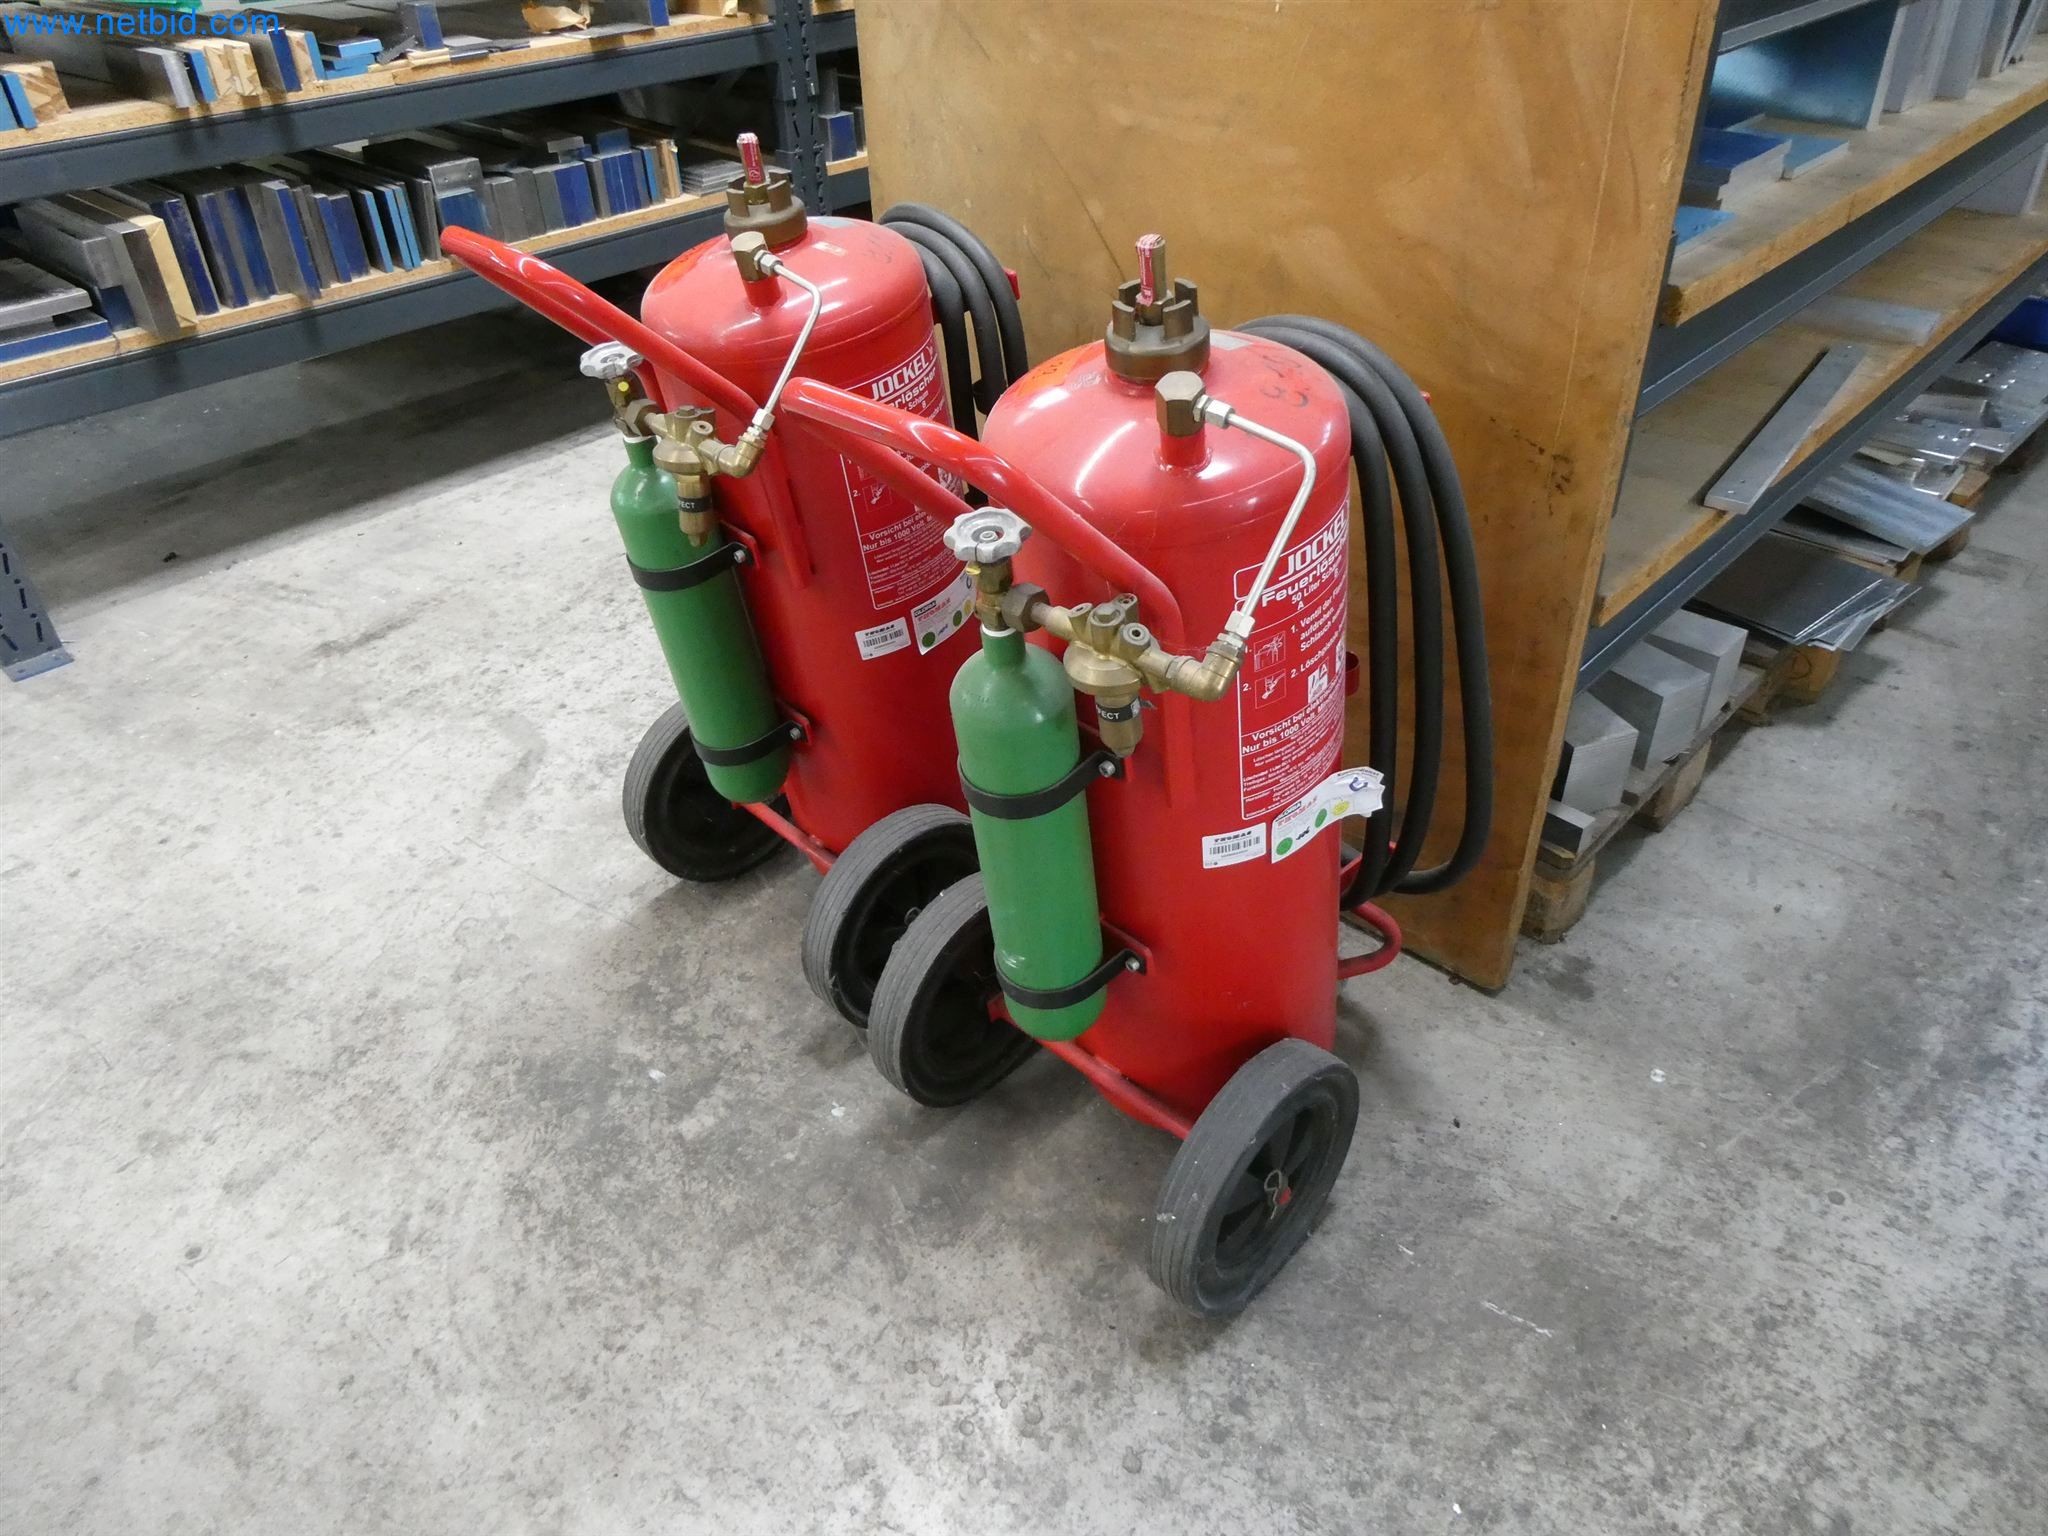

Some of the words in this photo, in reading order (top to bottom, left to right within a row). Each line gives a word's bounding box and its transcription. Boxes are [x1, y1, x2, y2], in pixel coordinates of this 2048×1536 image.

[871, 352, 929, 400] JOCKEL
[869, 524, 902, 540] Vorsicht
[863, 541, 877, 552] Nur
[1279, 509, 1345, 581] JOCKEL
[1292, 592, 1303, 604] 50
[1303, 579, 1321, 597] Liter
[1297, 601, 1304, 611] A
[1243, 683, 1251, 692] 2.
[1252, 719, 1291, 741] Vorsicht
[1293, 710, 1305, 723] bei
[1242, 742, 1260, 754] Nur
[1263, 737, 1277, 748] bis
[1280, 724, 1299, 739] 1000
